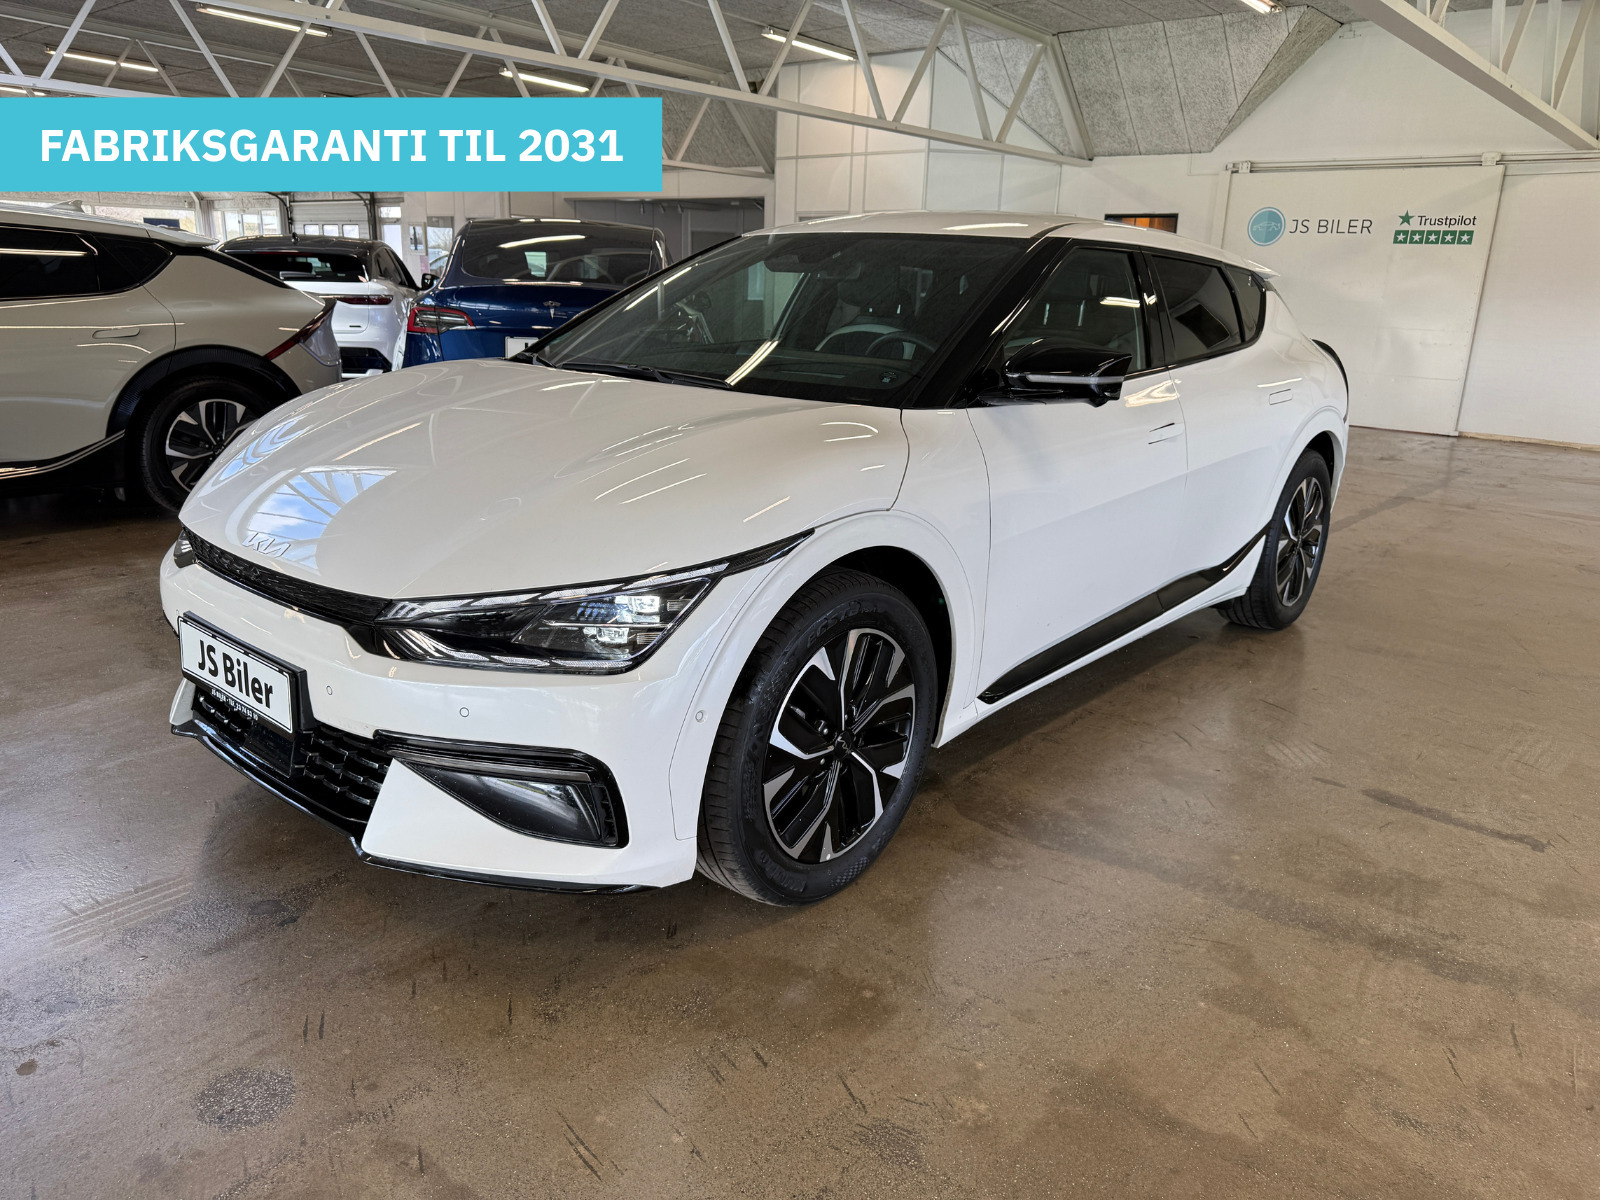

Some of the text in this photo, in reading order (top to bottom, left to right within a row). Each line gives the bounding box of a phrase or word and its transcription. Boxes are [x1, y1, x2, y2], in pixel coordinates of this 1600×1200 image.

[1289, 218, 1373, 234] JS BILER
[1418, 215, 1477, 228] Trustpilot
[198, 639, 273, 709] JS Biler
